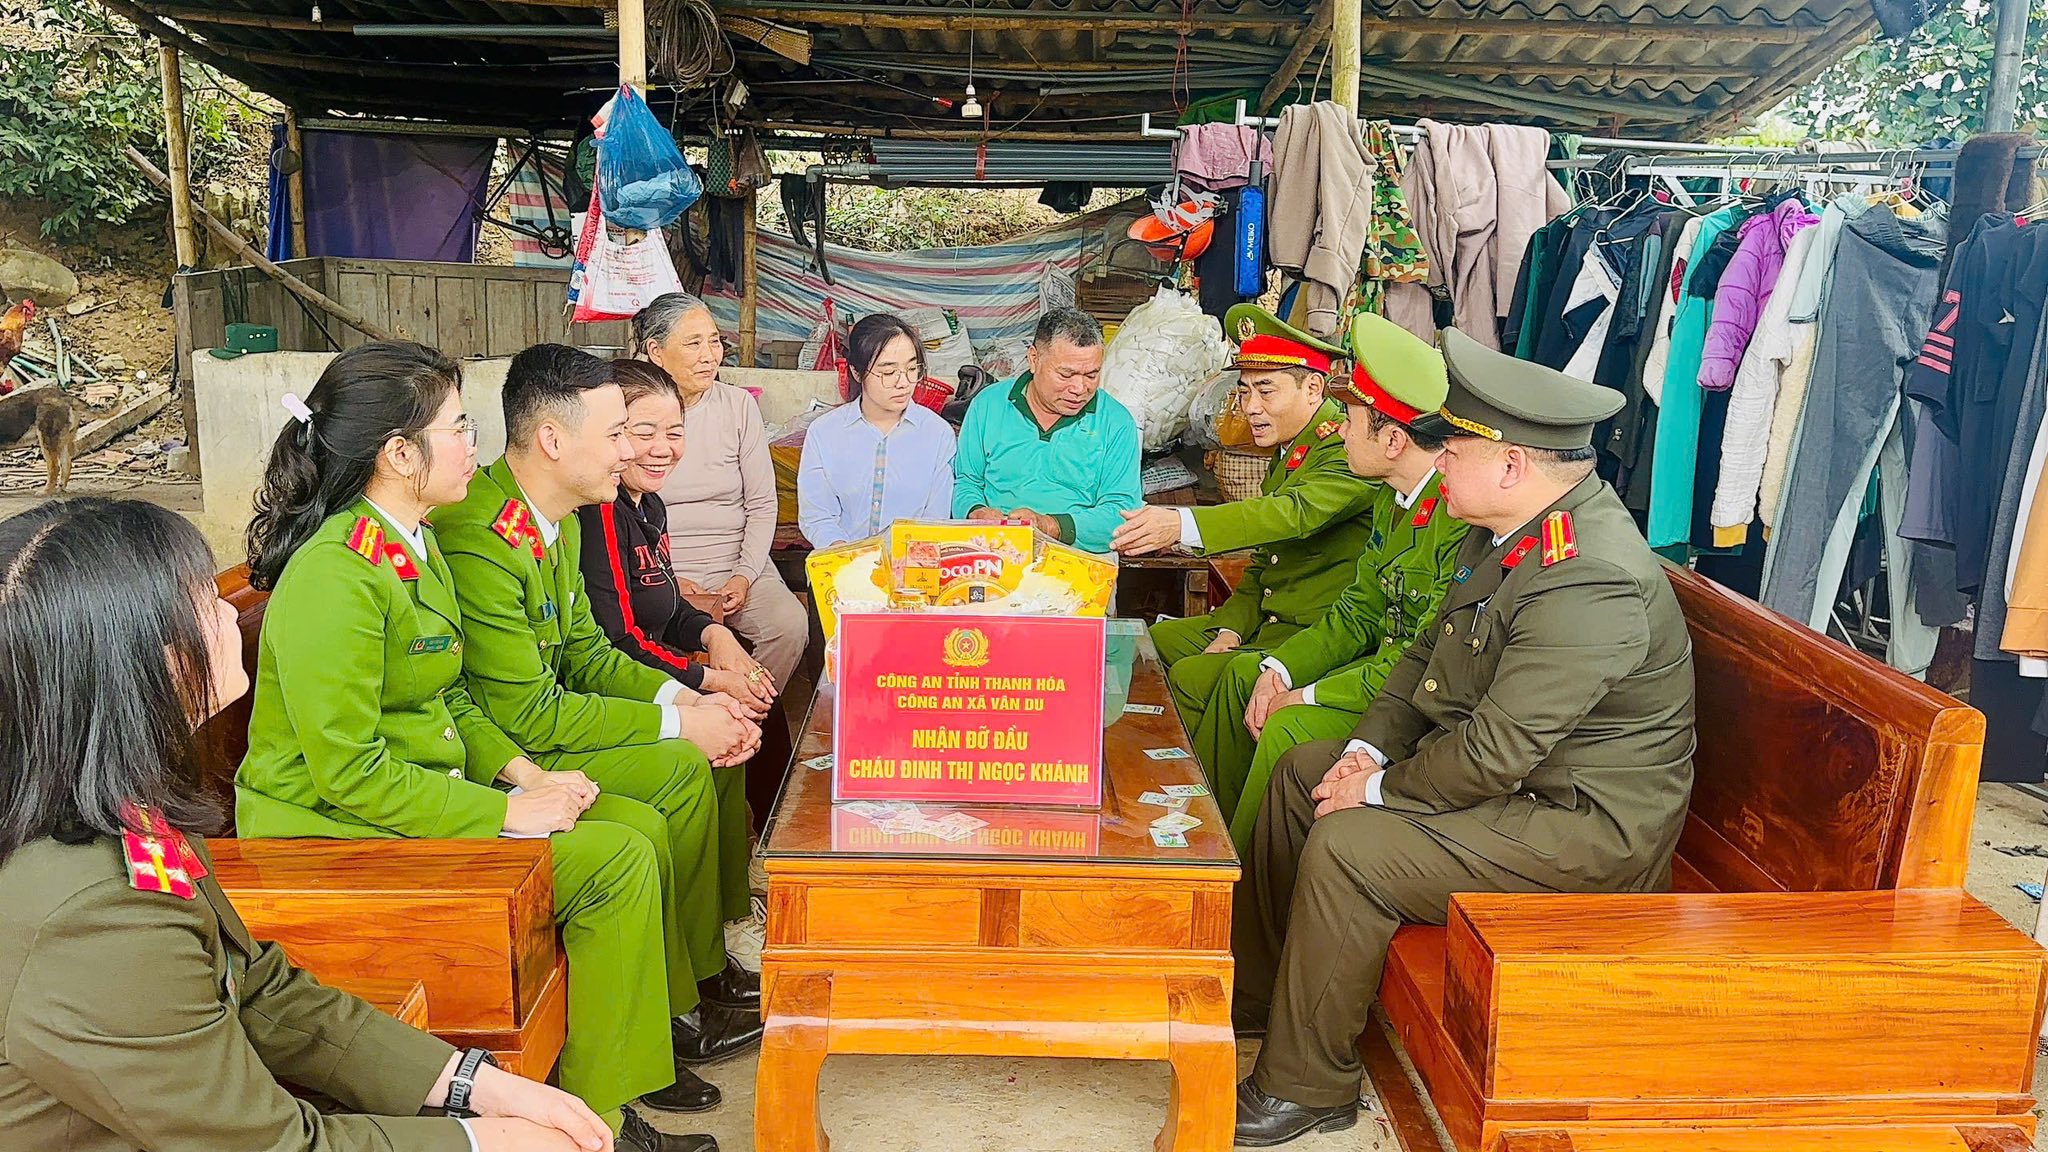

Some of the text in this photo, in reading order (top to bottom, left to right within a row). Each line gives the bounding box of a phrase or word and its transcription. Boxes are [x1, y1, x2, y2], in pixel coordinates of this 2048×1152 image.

[876, 671, 1066, 691] CÔNG AN TỈNH THANH HÓA
[897, 694, 1044, 711] CÔNG AN XÃ VÂN DU
[912, 724, 1028, 752] NHẬN ĐỠ ĐẦU
[849, 756, 1089, 785] CHÁU ĐINH THỊ NGỌC KHÁNH
